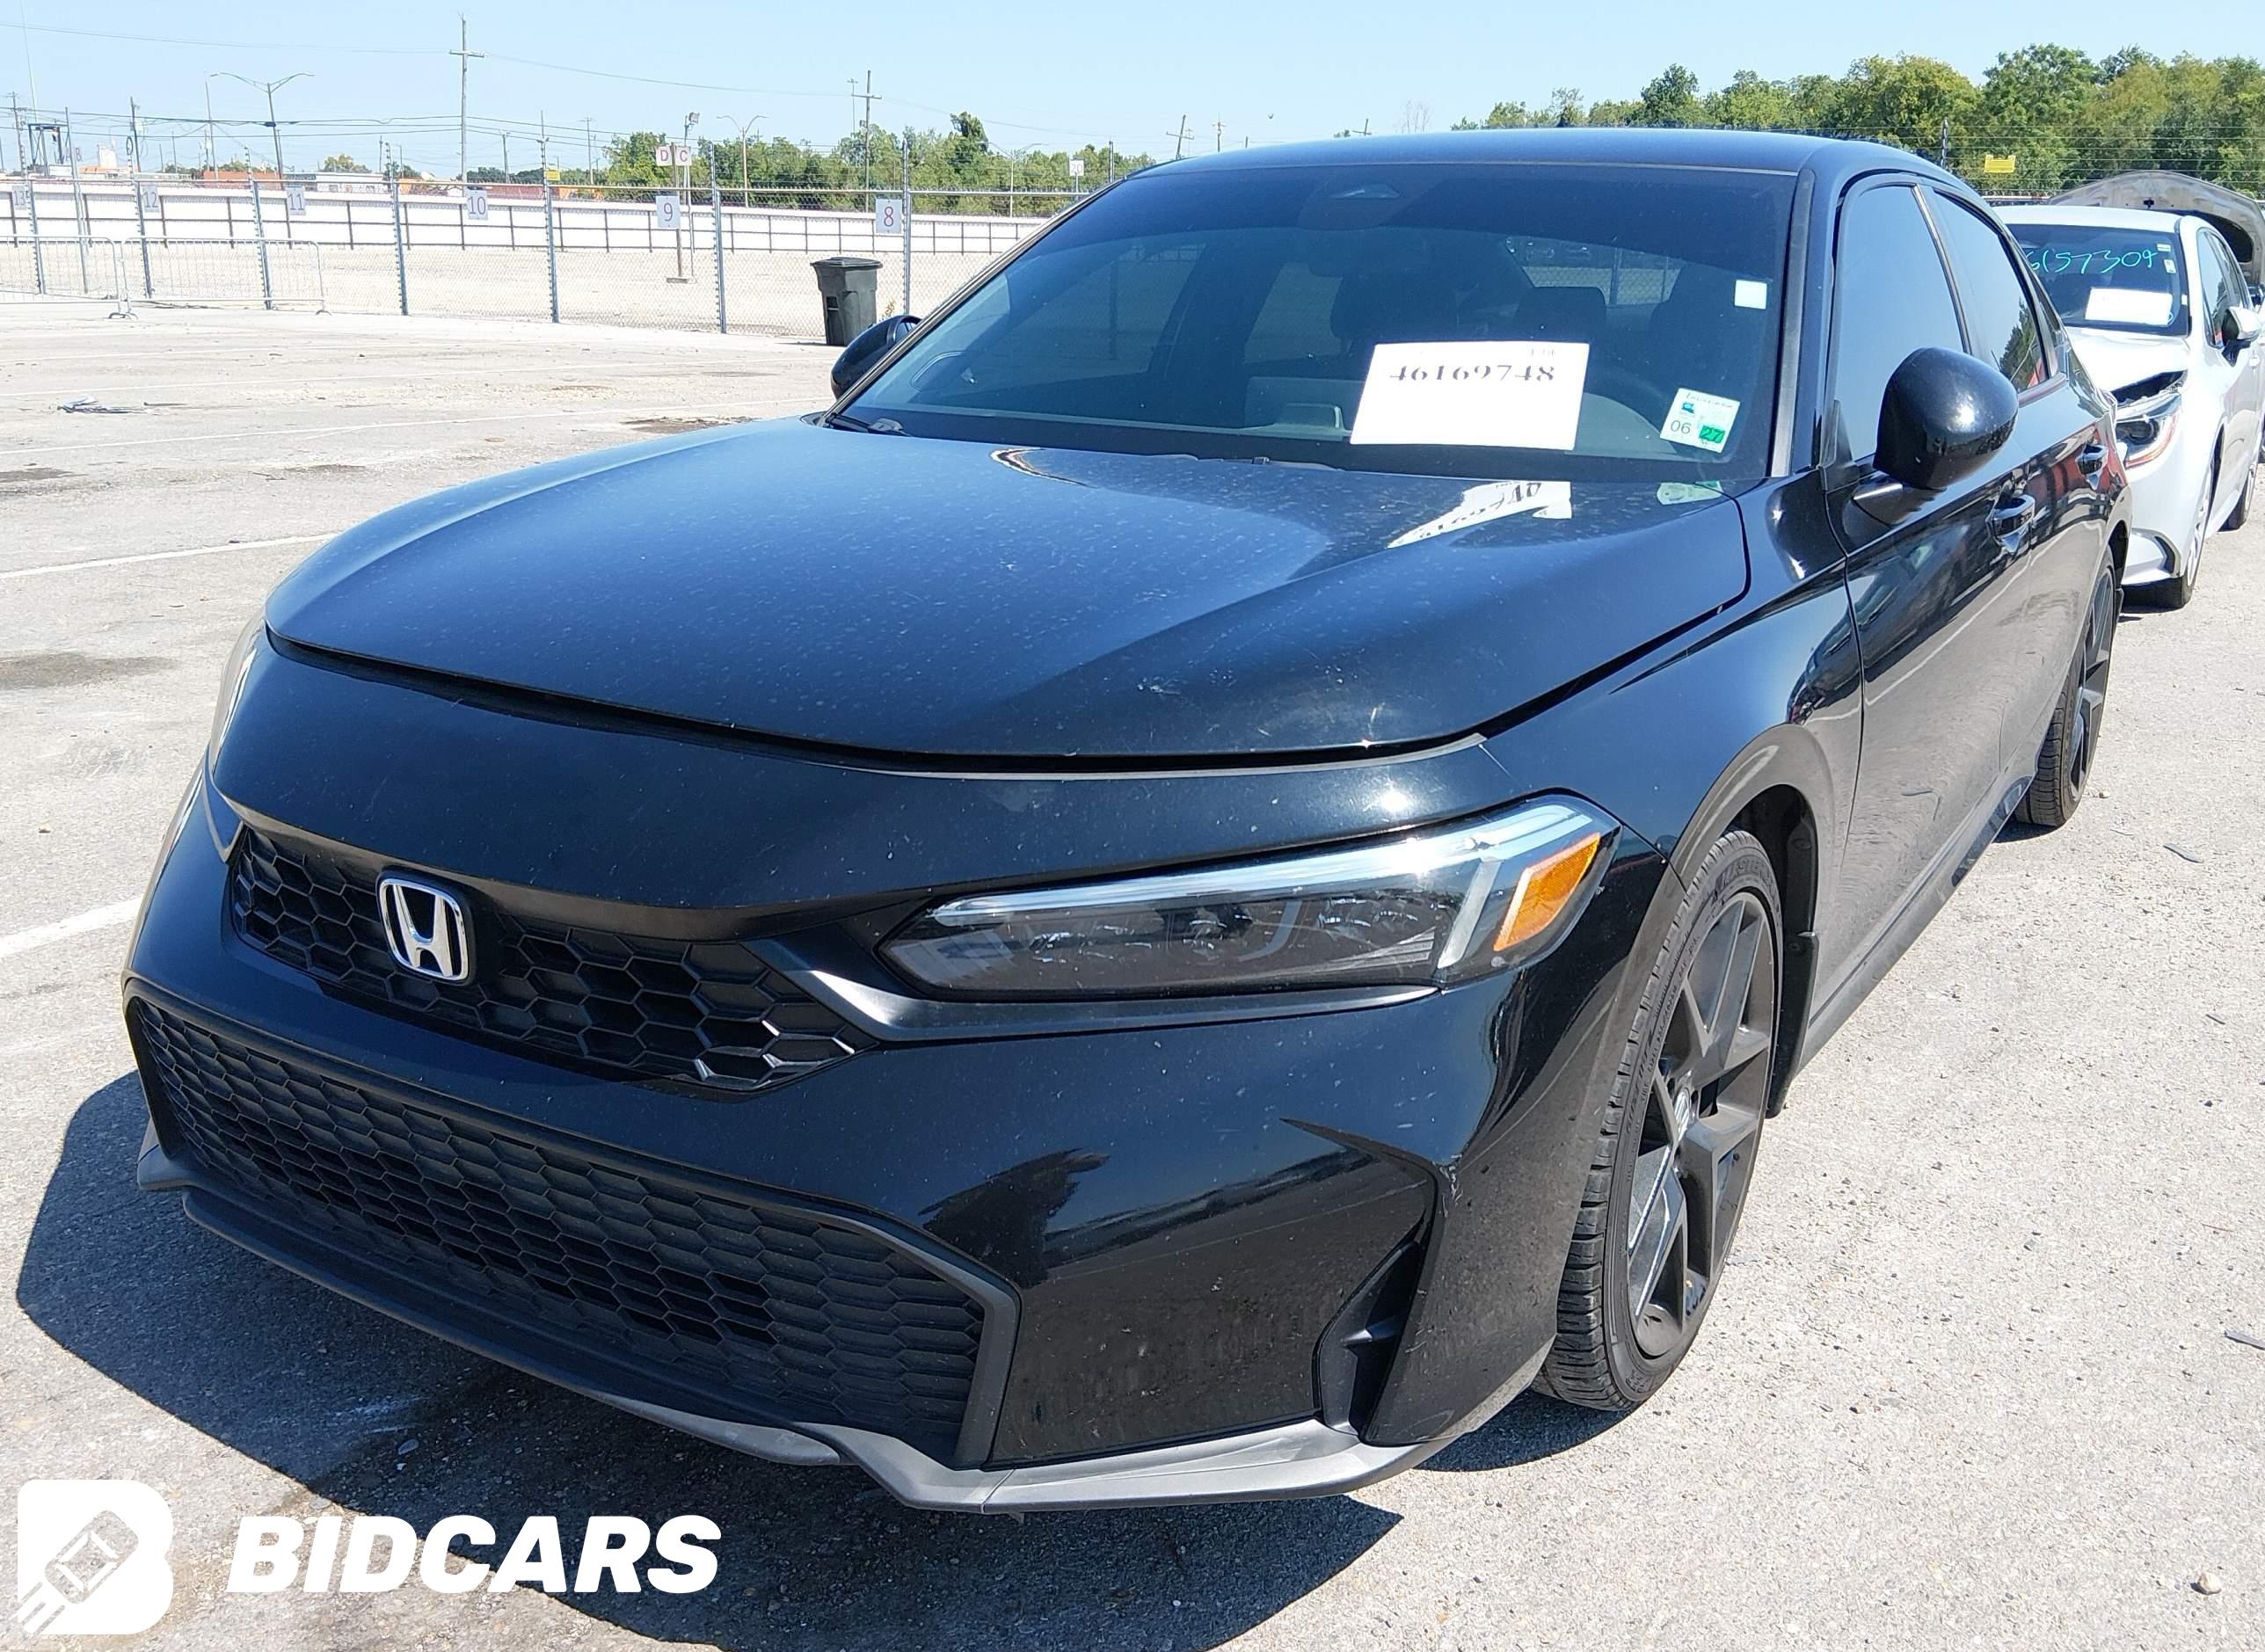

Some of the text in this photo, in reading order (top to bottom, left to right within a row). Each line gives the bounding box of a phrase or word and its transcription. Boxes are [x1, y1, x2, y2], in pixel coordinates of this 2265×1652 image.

[660, 150, 668, 162] D
[680, 150, 688, 162] C
[14, 190, 26, 206] 13
[142, 192, 159, 207] 12
[288, 193, 305, 210] 11
[468, 196, 486, 215] 10
[663, 202, 674, 222] 9
[884, 206, 894, 227] 8
[1389, 365, 1555, 381] 46169748
[1671, 419, 1692, 434] 06
[1701, 426, 1724, 443] 27
